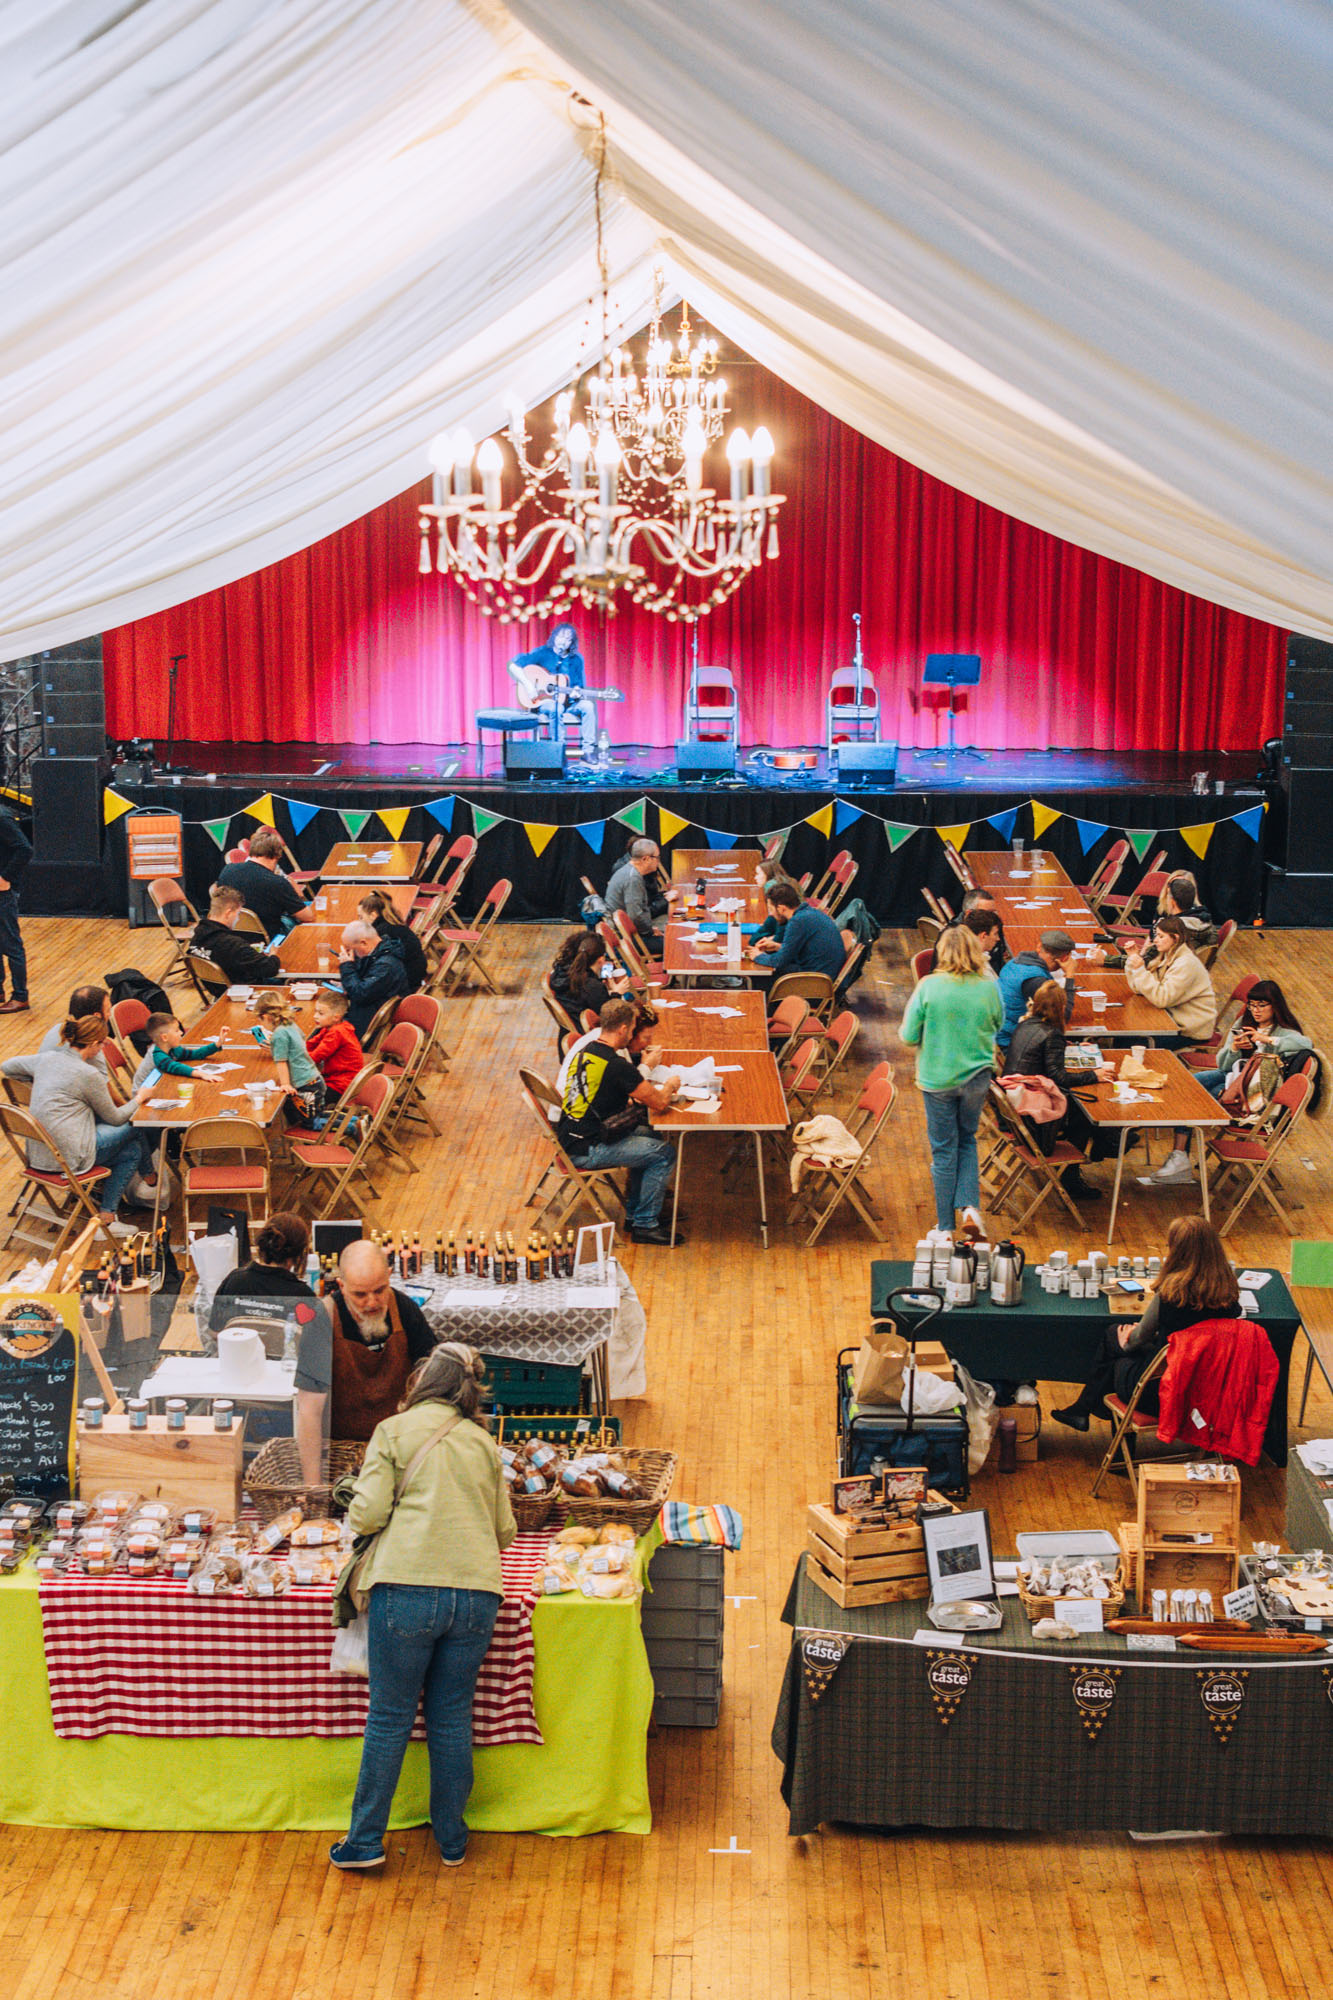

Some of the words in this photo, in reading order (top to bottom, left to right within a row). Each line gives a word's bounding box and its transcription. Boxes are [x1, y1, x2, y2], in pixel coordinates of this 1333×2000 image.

[815, 1639, 835, 1648] great
[806, 1643, 842, 1661] taste
[940, 1665, 960, 1674] great
[932, 1671, 968, 1685] taste
[1085, 1680, 1105, 1688] great
[1212, 1683, 1233, 1692] great
[1076, 1685, 1114, 1699] taste
[1205, 1688, 1242, 1702] taste
